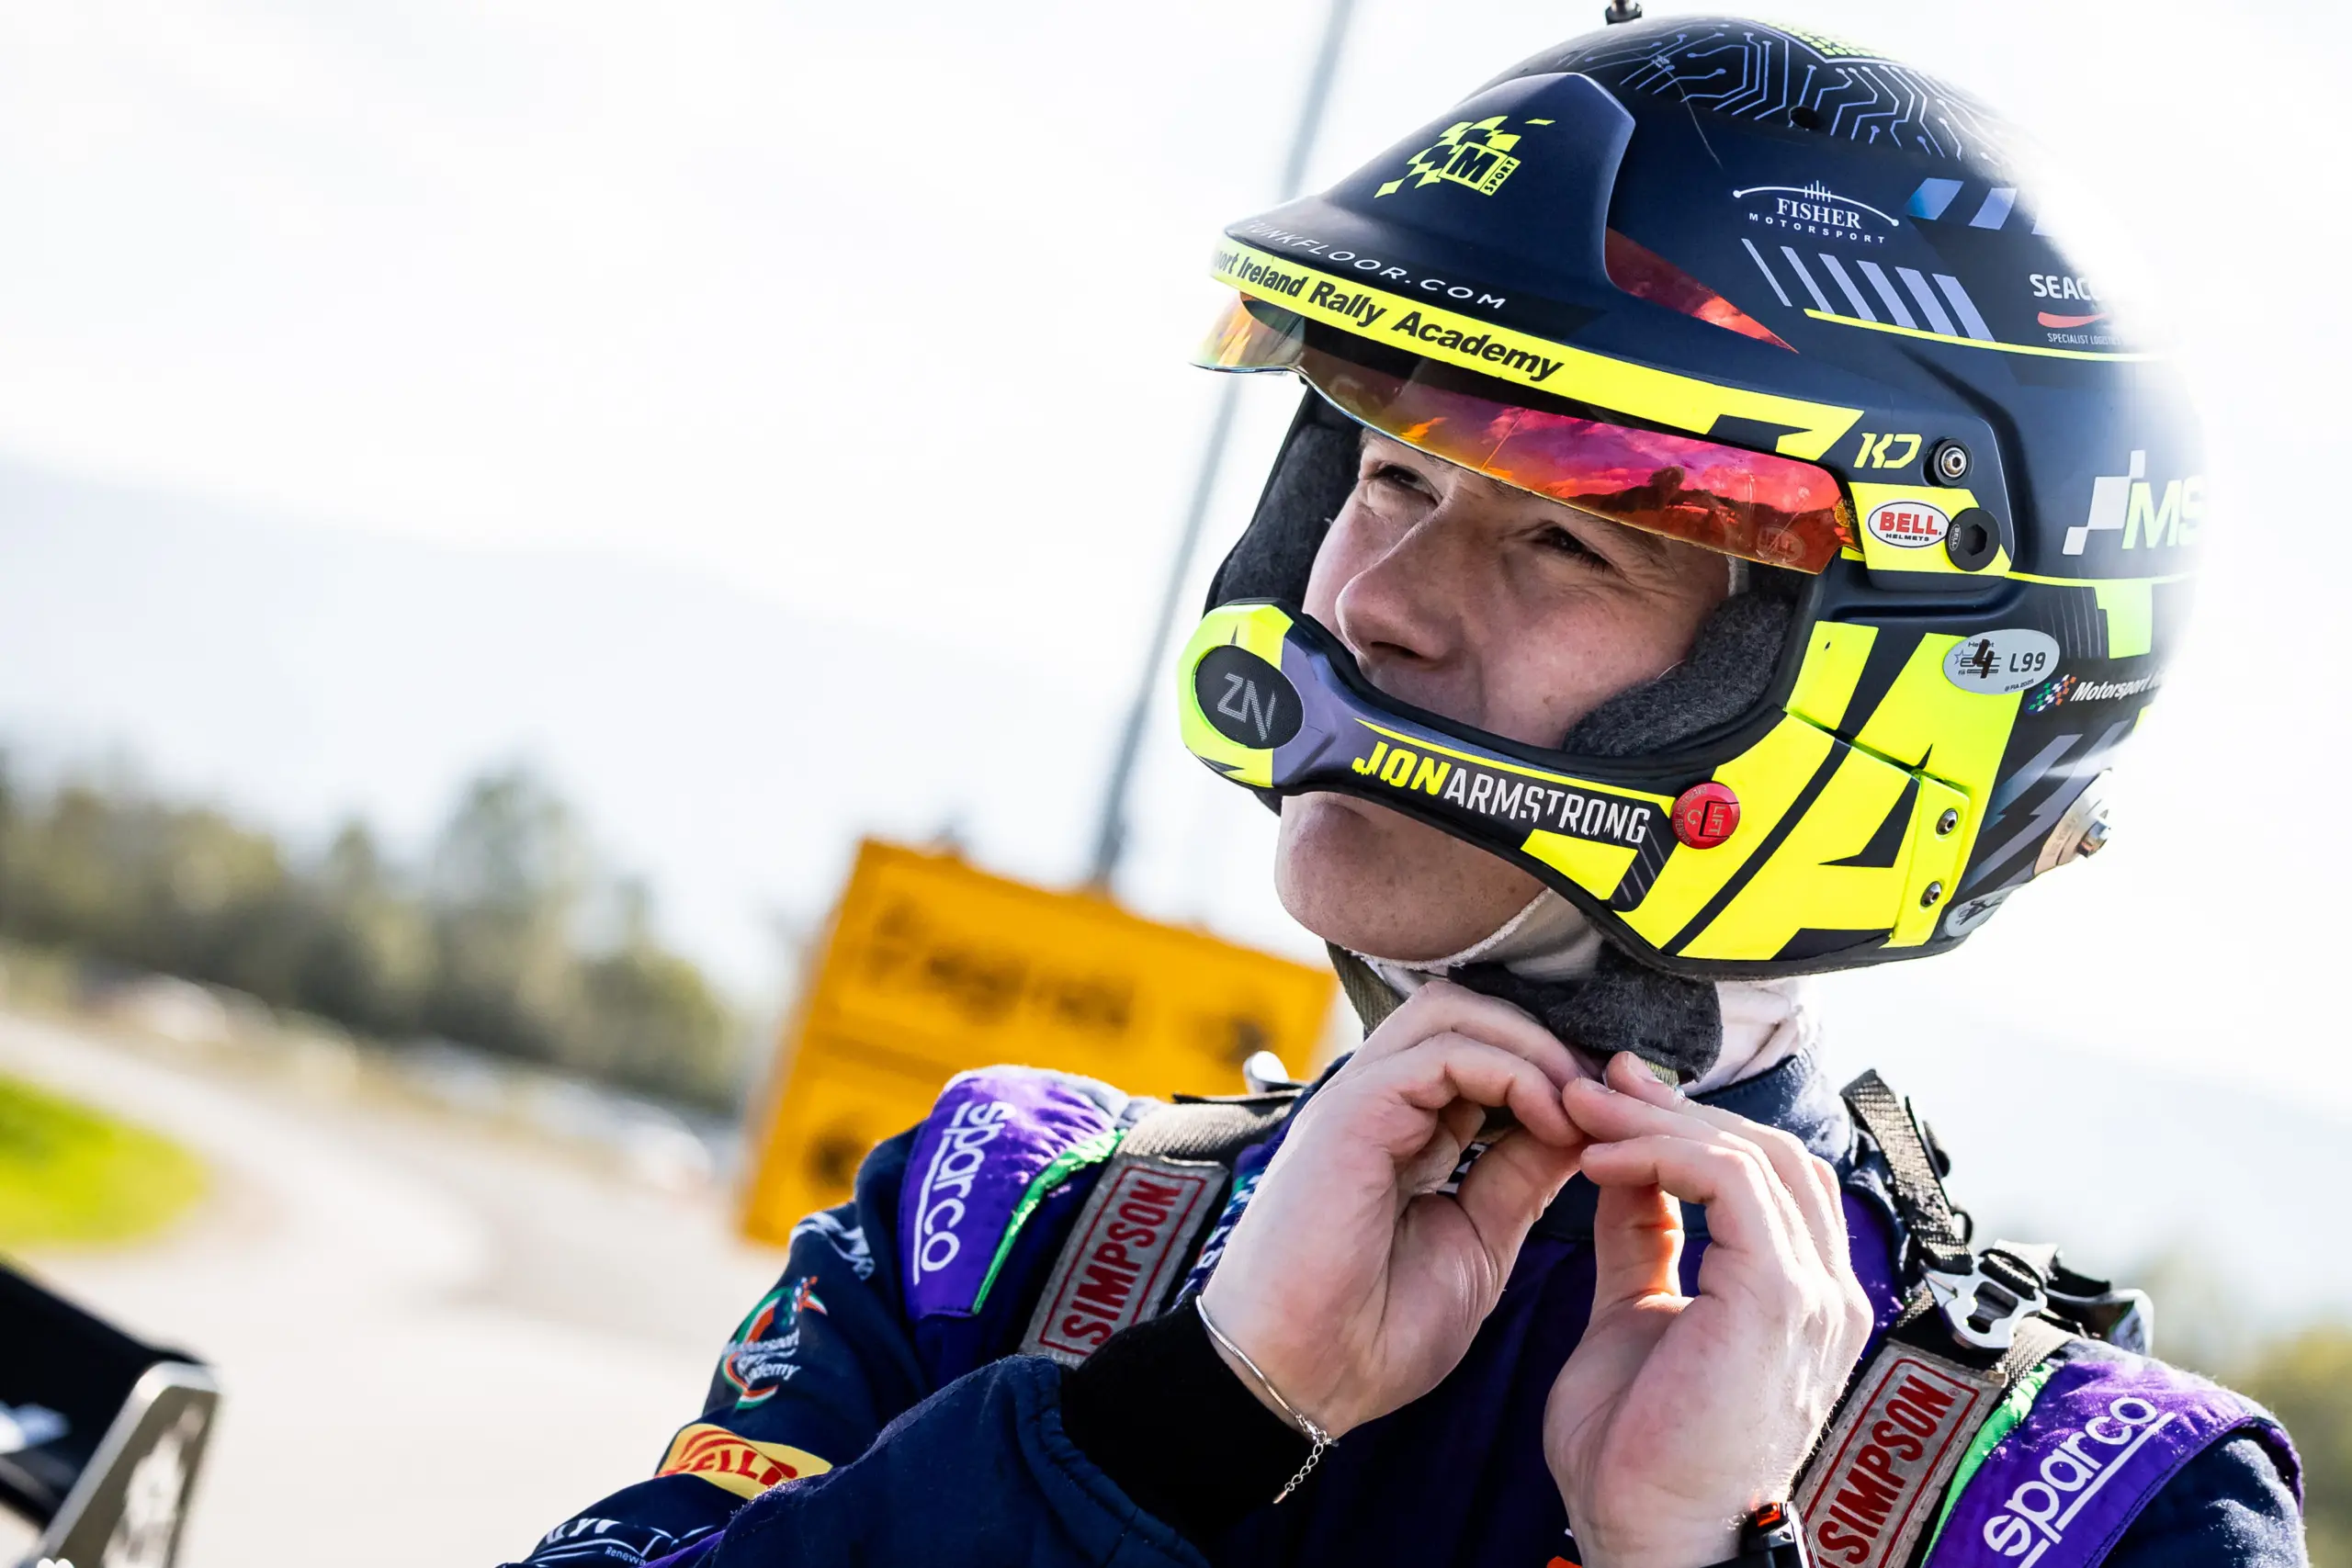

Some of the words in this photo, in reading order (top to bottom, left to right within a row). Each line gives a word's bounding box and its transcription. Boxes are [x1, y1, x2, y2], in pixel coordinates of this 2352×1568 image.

[1485, 160, 1516, 193] SPORT
[1748, 212, 1885, 243] MOTORSPORT
[1776, 197, 1861, 229] FISHER
[1237, 256, 1309, 298] Ireland
[1308, 280, 1387, 328] Rally
[1391, 310, 1565, 382] Academy
[2047, 332, 2089, 344] SPECIALIST
[1879, 511, 1939, 536] BELL
[1885, 533, 1929, 542] HELMETS
[2009, 651, 2046, 672] L99
[2070, 675, 2151, 702] Motorsport
[1710, 806, 1725, 836] LIFT
[922, 1101, 1016, 1272] sparco
[1062, 1179, 1182, 1345] SIMPSON
[1817, 1374, 1956, 1564] SIMPSON
[1983, 1397, 2159, 1558] sparco
